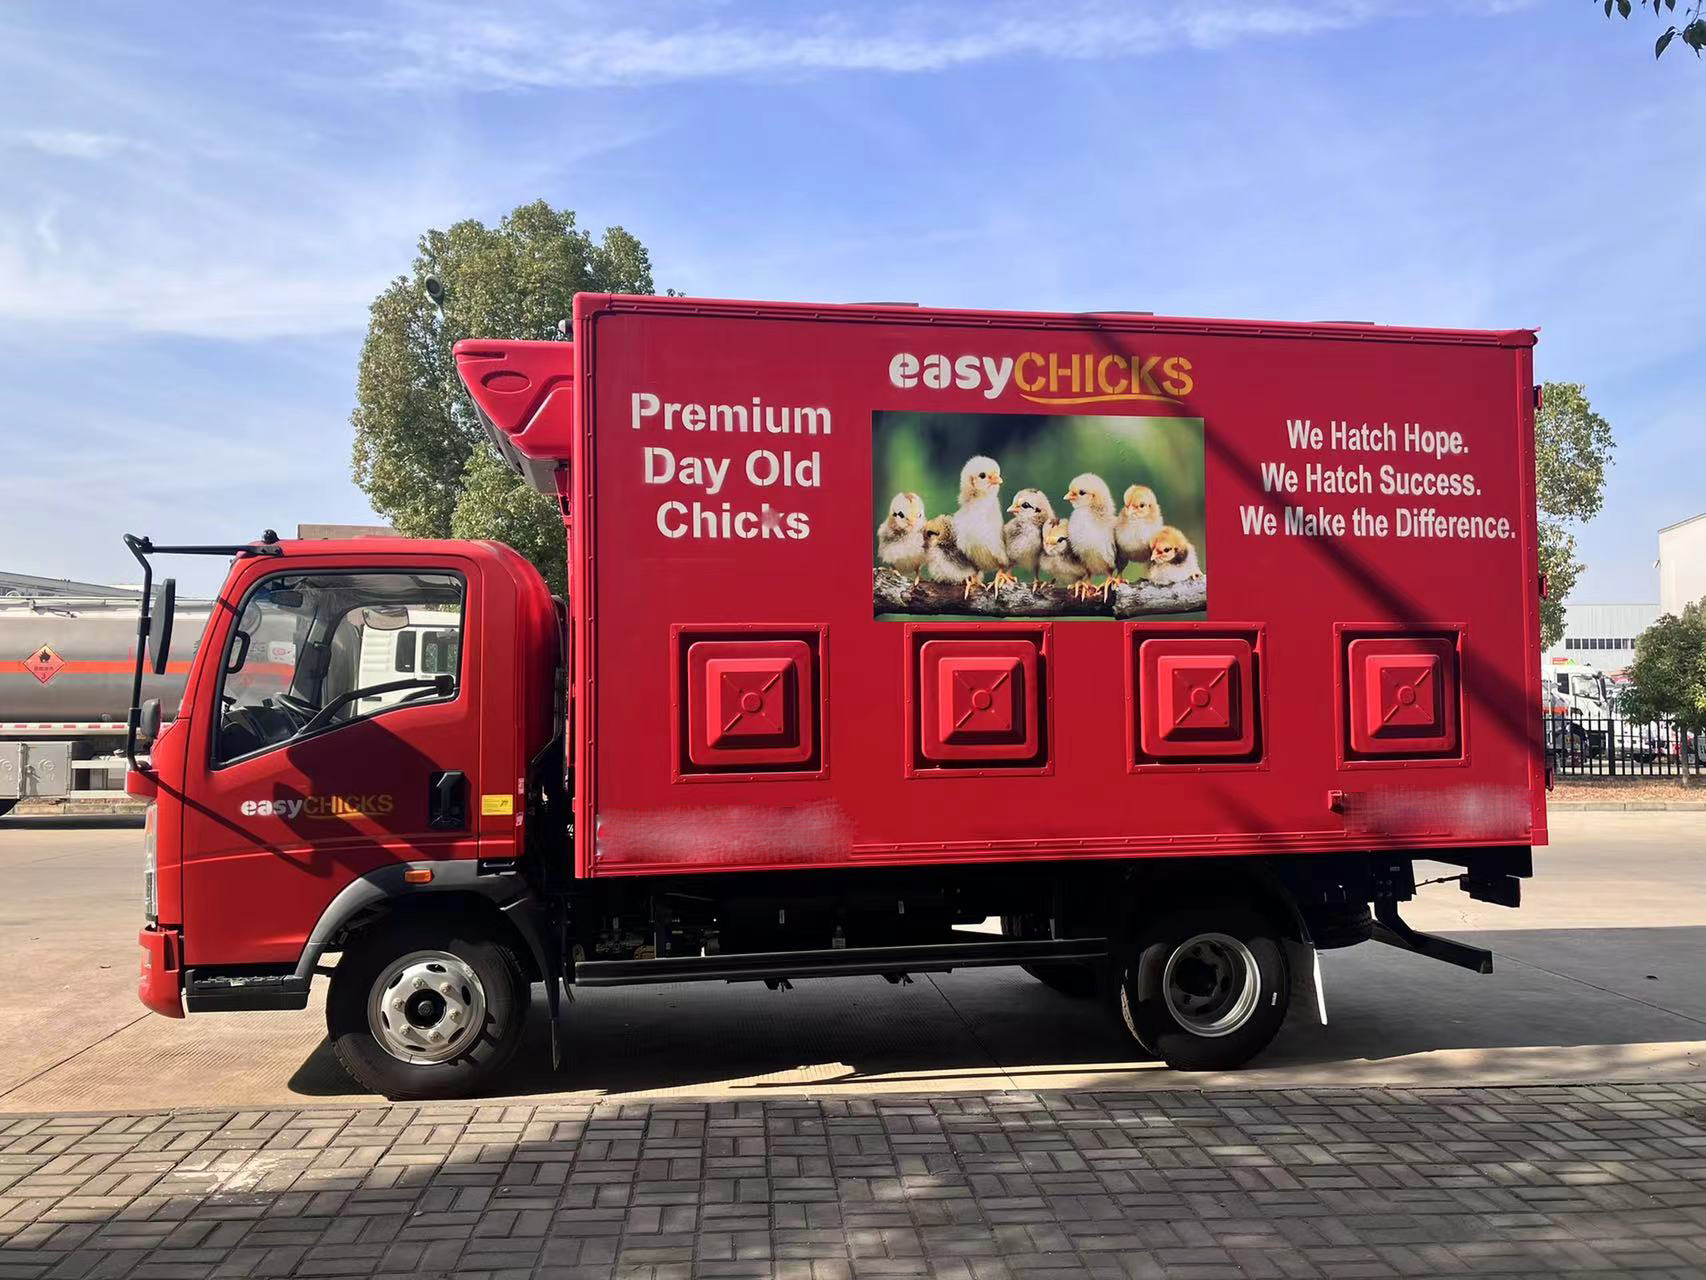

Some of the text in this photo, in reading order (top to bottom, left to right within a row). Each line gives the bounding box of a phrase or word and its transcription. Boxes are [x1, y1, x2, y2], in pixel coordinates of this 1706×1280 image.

[889, 351, 1194, 399] easyCHICKS
[631, 392, 832, 435] Premium
[1286, 420, 1469, 460] We Hatch Hope.
[643, 446, 821, 495] Day Old
[1261, 462, 1482, 497] We Hatch Success.
[656, 500, 811, 540] Chicks
[1239, 505, 1516, 539] We Make the Difference.
[240, 794, 394, 819] easyCHICKS
